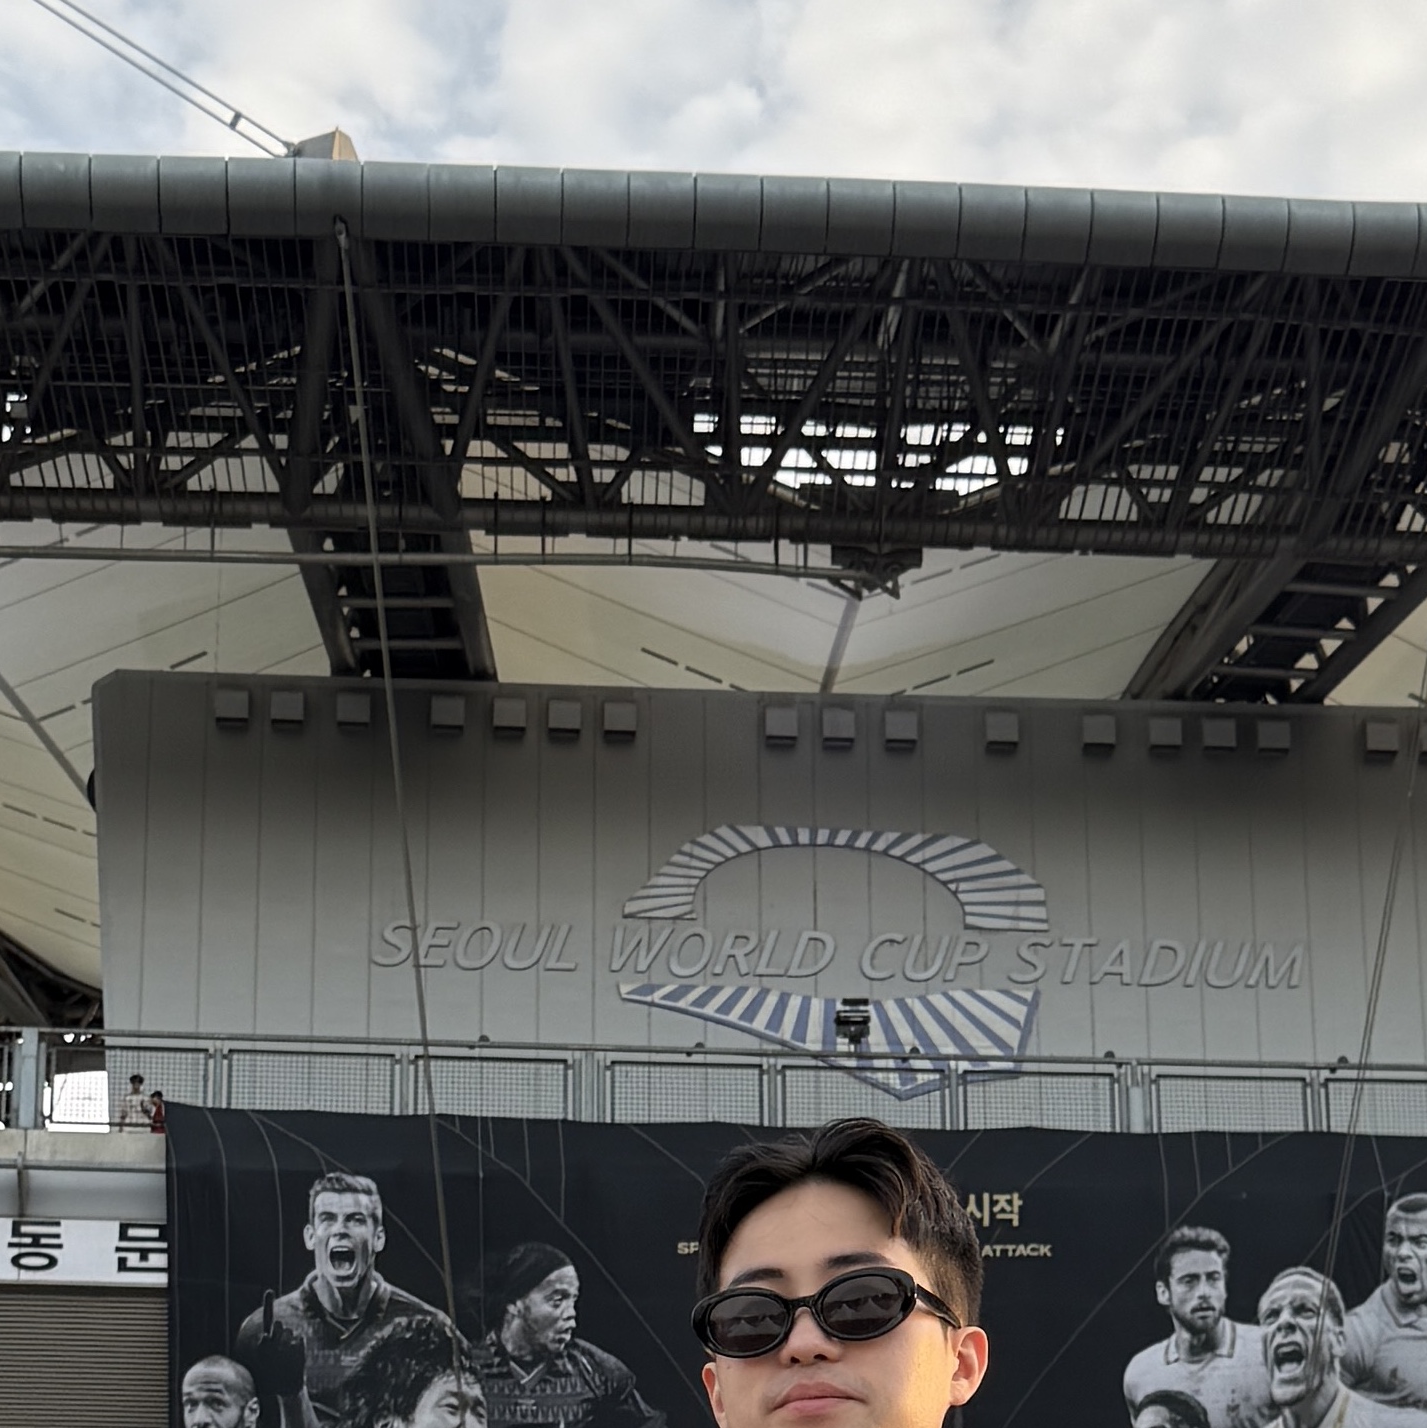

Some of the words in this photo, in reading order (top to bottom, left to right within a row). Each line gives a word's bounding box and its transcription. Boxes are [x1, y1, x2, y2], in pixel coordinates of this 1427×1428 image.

[372, 920, 578, 972] SEOUL
[609, 924, 835, 979] WORLD
[859, 932, 990, 984] CUP
[1007, 937, 1306, 990] STADIUM
[966, 1186, 1024, 1228] 시작
[981, 1243, 1052, 1258] ATTACK
